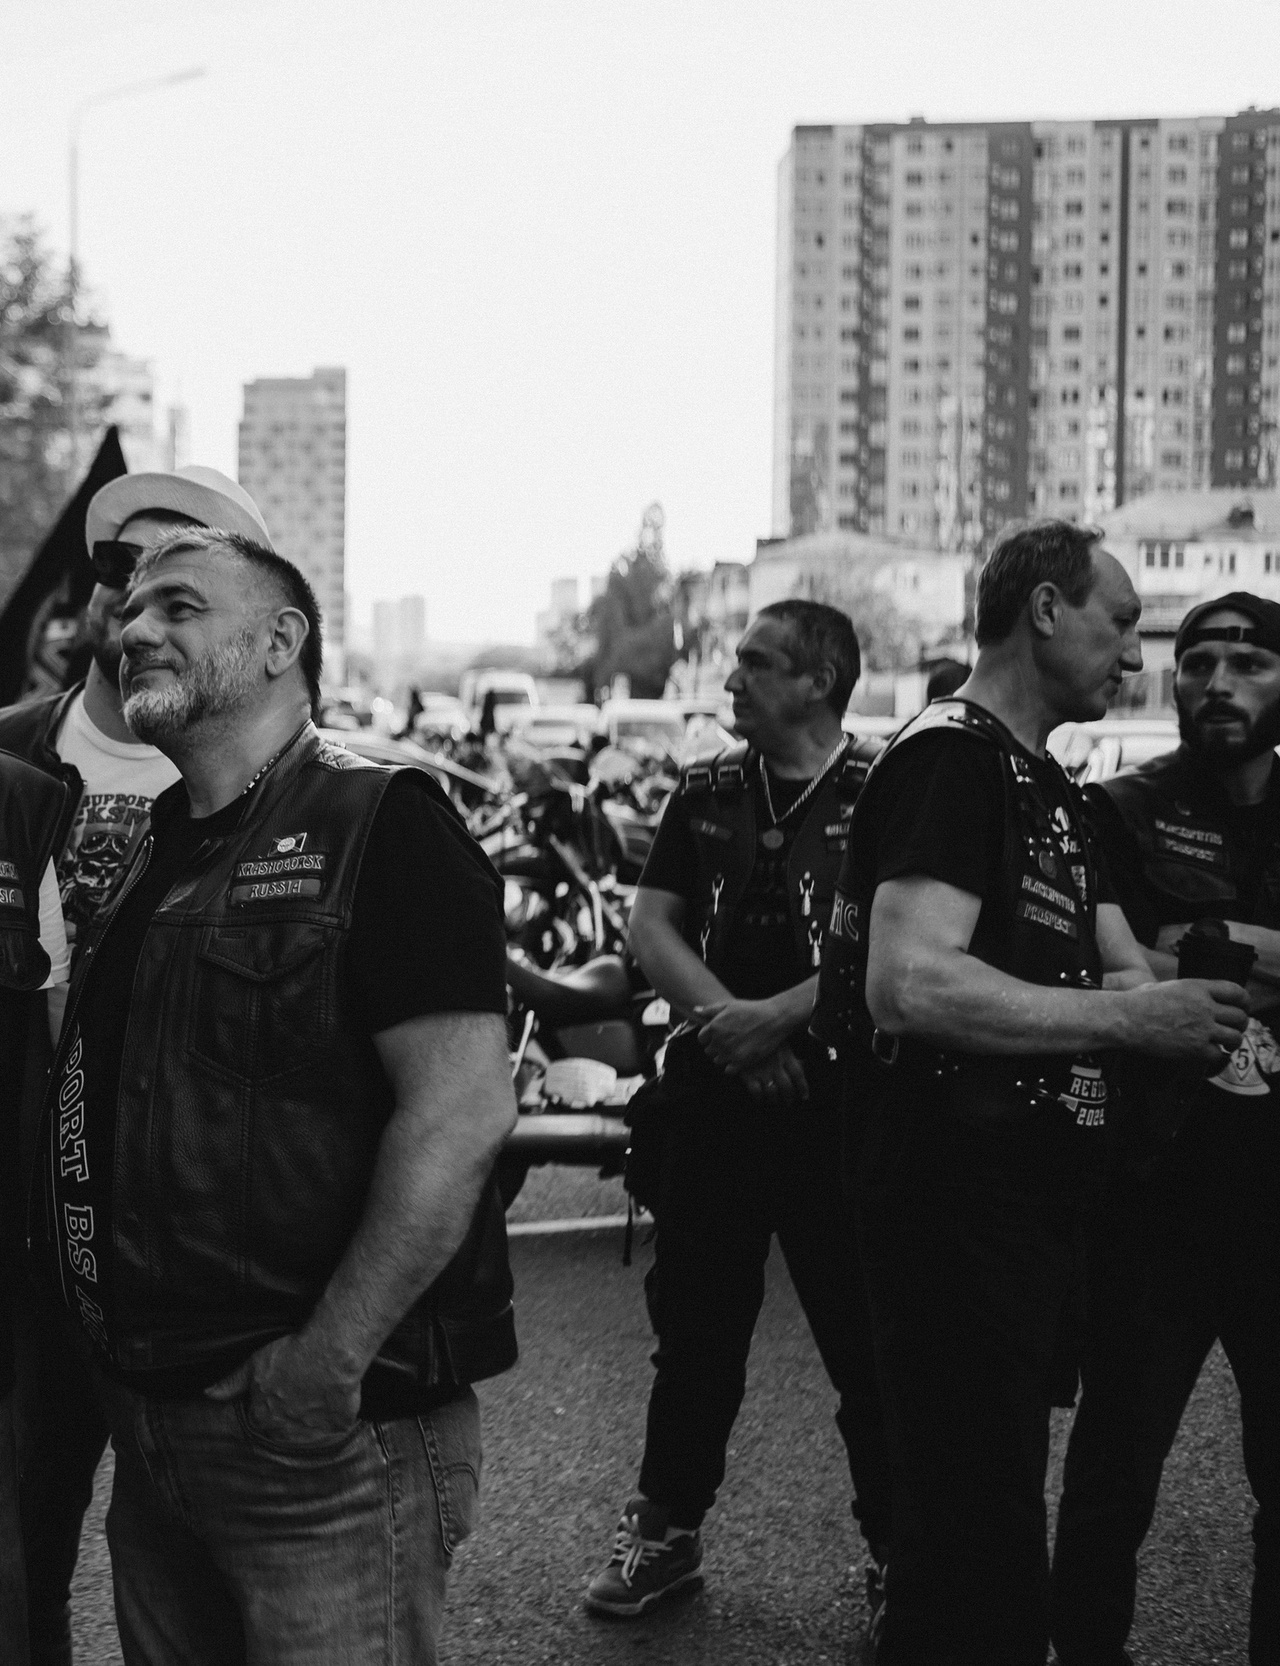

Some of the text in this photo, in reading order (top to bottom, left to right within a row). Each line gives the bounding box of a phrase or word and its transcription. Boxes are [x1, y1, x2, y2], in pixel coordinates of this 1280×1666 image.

[238, 854, 324, 877] KRASNOGORSK
[250, 880, 302, 898] RUSSIA
[1023, 902, 1071, 934] PROSPECT
[1236, 1048, 1249, 1071] 5
[64, 1203, 97, 1284] BS
